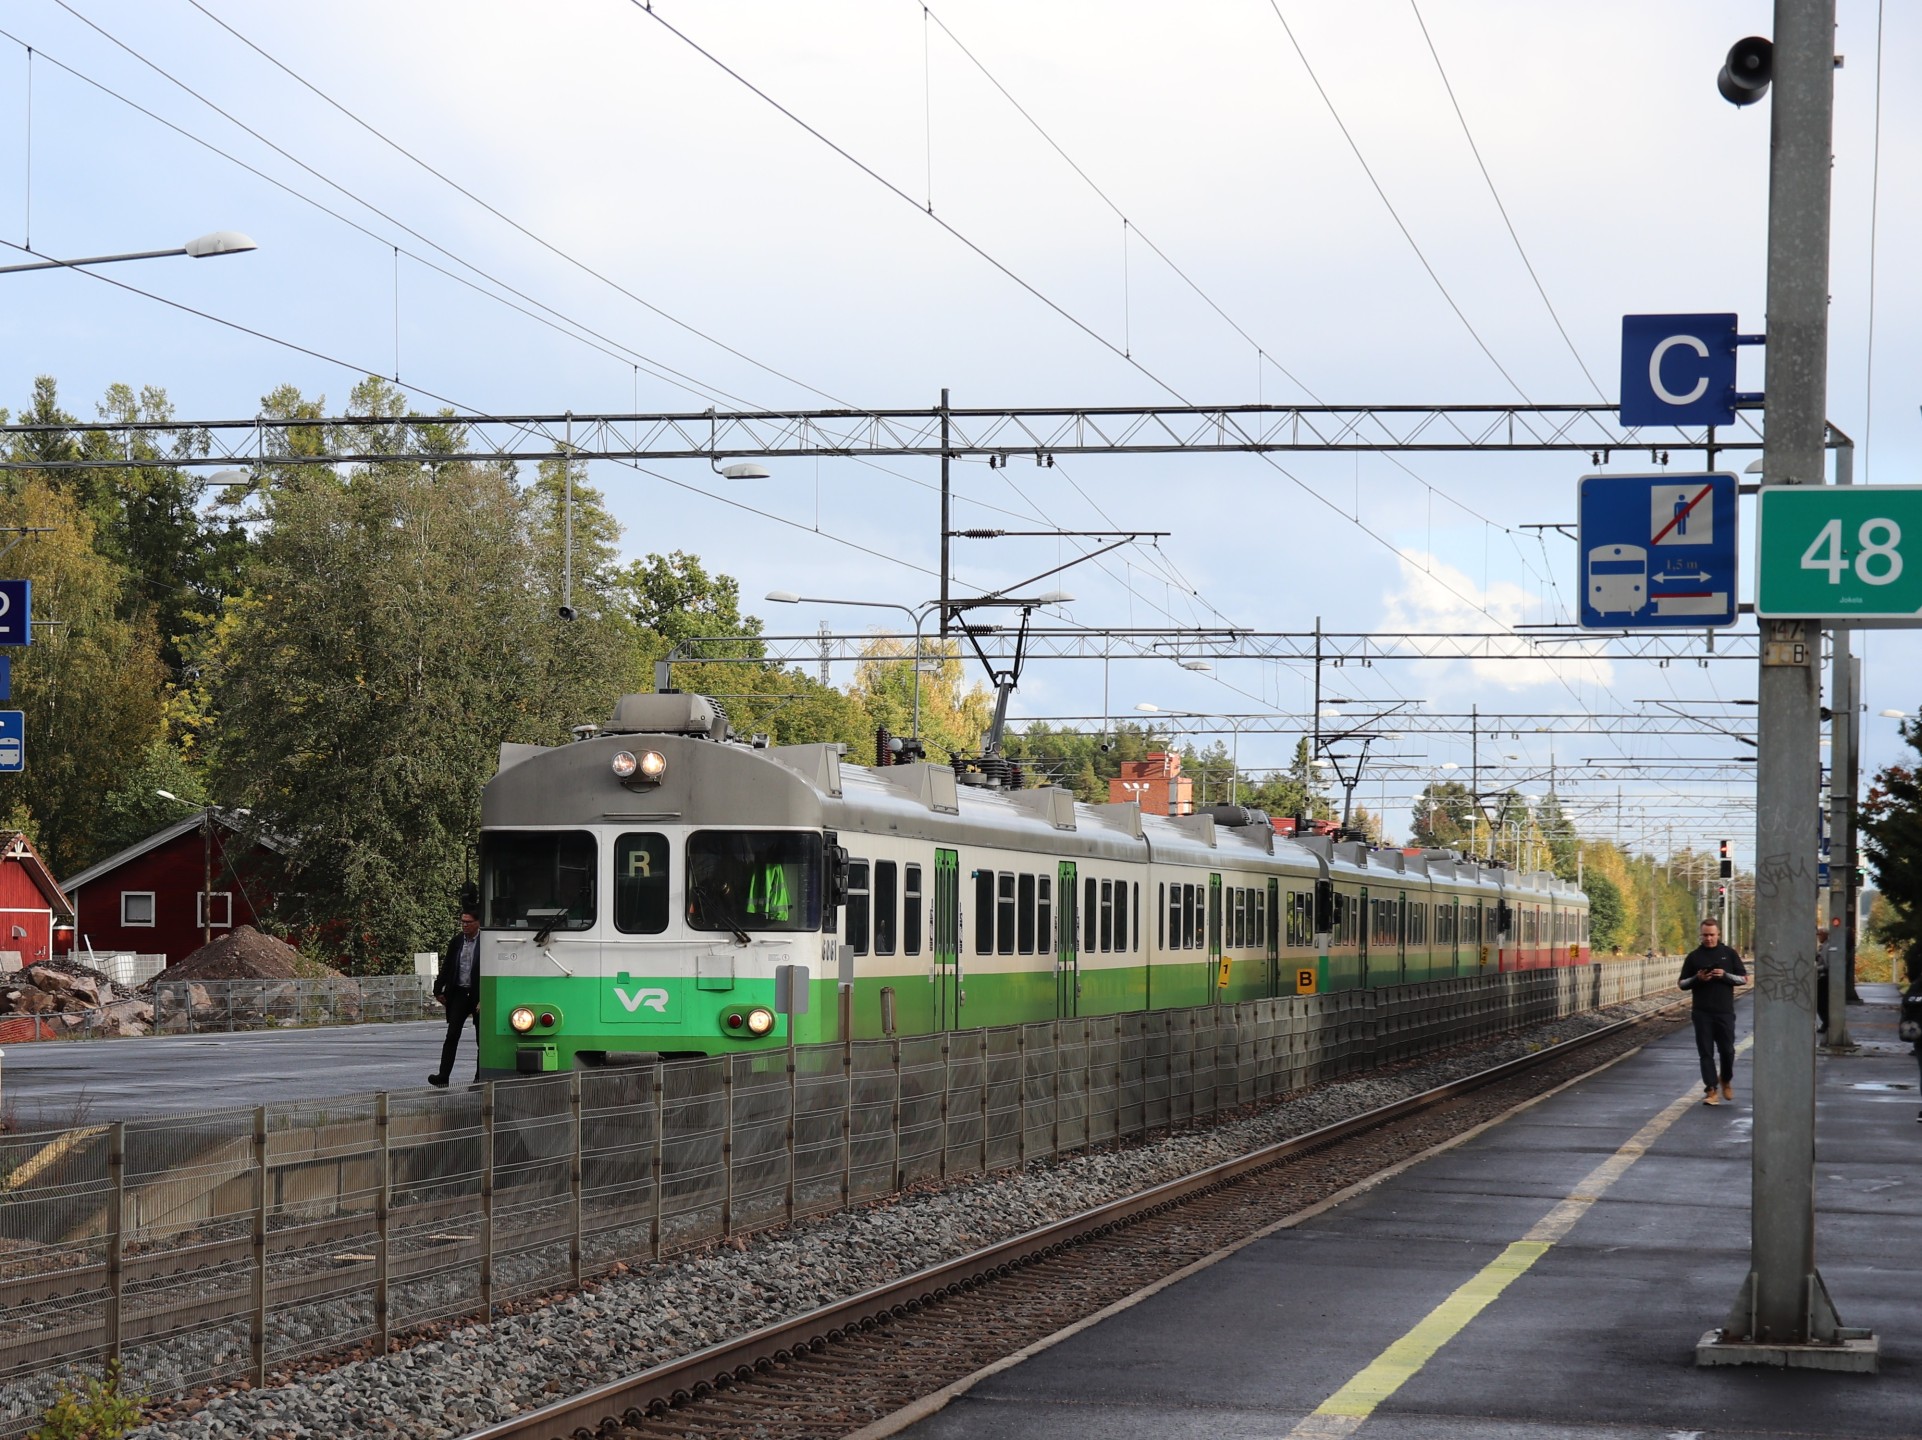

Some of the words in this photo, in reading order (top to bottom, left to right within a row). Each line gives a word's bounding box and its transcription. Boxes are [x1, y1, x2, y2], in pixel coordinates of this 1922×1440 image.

[1649, 335, 1710, 405] C
[1800, 518, 1903, 586] 48
[1686, 561, 1698, 570] m
[628, 850, 651, 878] R
[1223, 964, 1229, 974] 1
[1300, 971, 1313, 987] B
[613, 988, 669, 1012] VR
